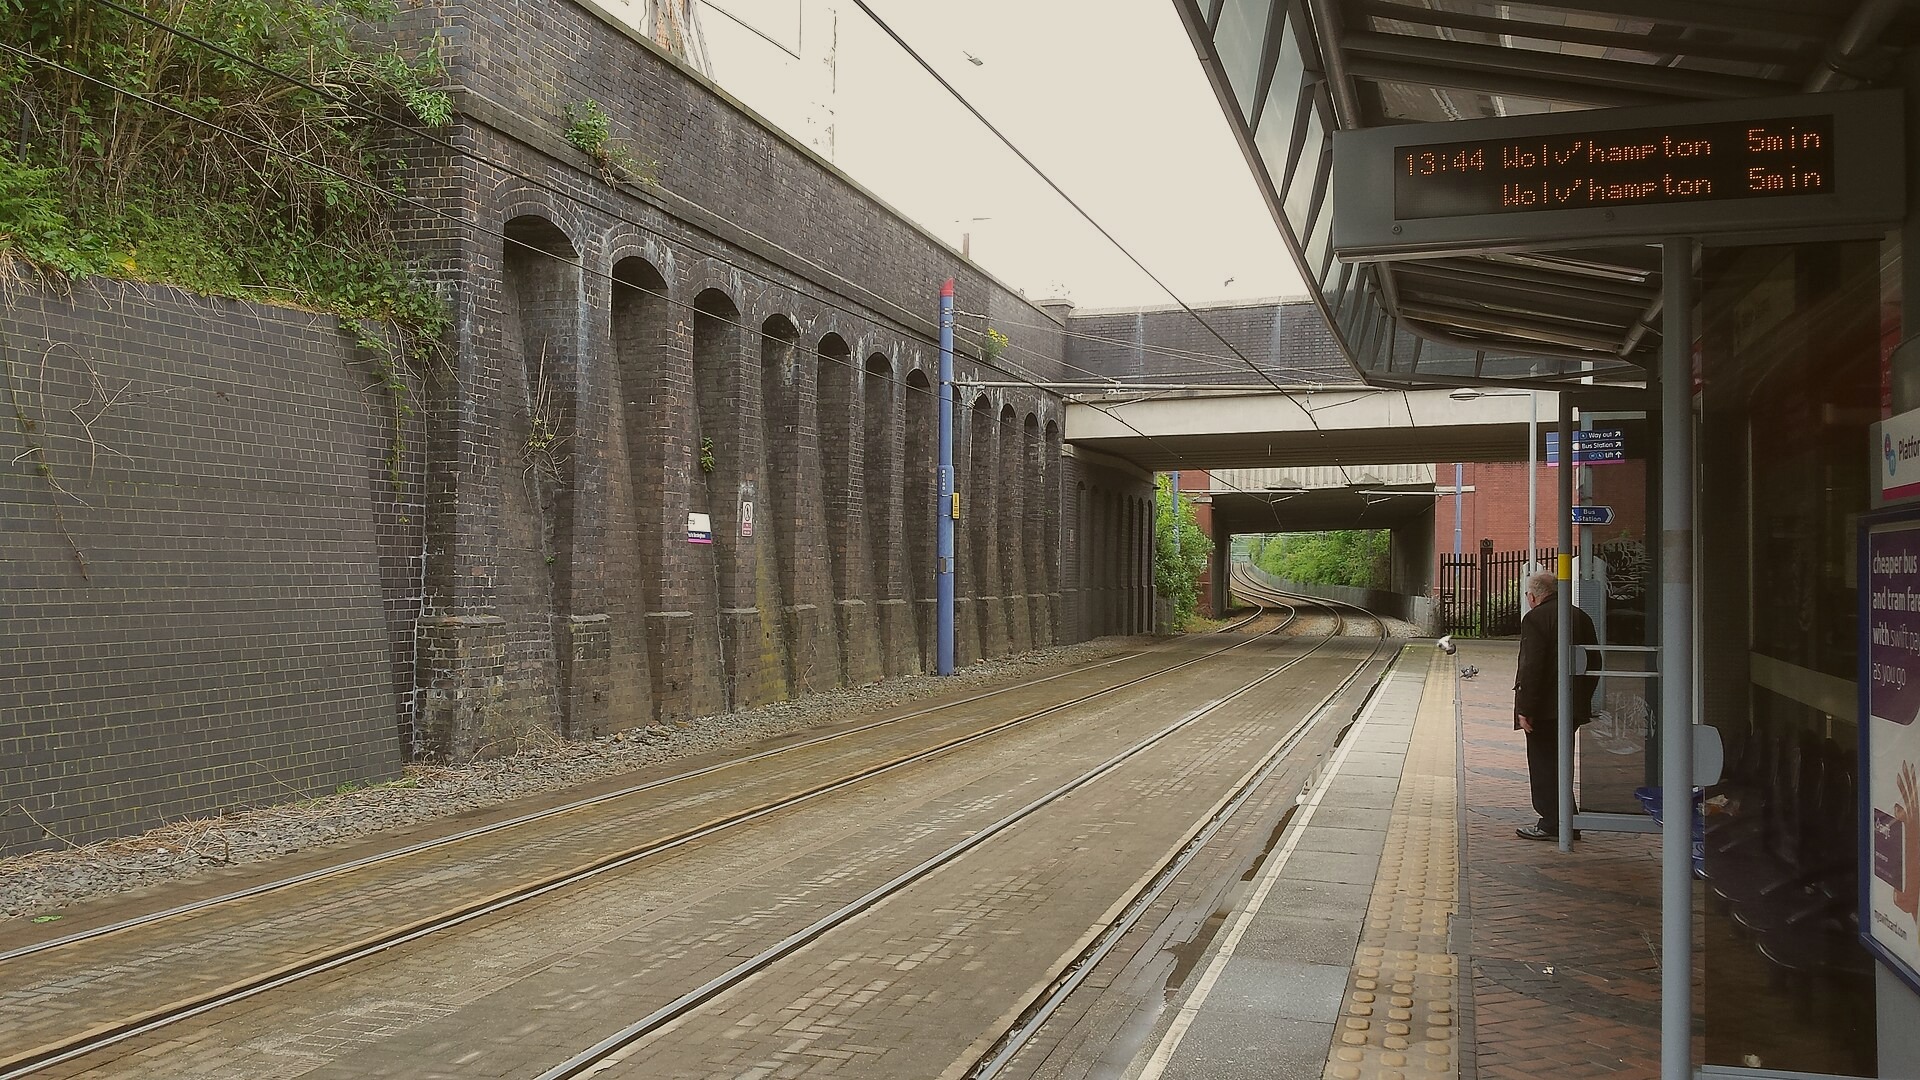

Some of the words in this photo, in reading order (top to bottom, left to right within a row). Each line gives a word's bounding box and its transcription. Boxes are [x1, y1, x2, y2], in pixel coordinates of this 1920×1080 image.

[1405, 148, 1485, 176] 13:44
[1503, 135, 1711, 169] Wolv'hampton
[1748, 126, 1820, 152] 5min
[1503, 173, 1712, 207] Wolv'hampton
[1749, 165, 1821, 190] 5min
[1593, 441, 1614, 449] Station
[1872, 549, 1902, 579] cheaper
[1903, 548, 1918, 574] bus
[1872, 585, 1886, 610] and
[1887, 588, 1906, 611] tram
[1872, 621, 1890, 646] with
[1890, 623, 1908, 649] swift
[1873, 663, 1882, 681] as
[1882, 664, 1896, 687] you
[1896, 667, 1906, 690] go
